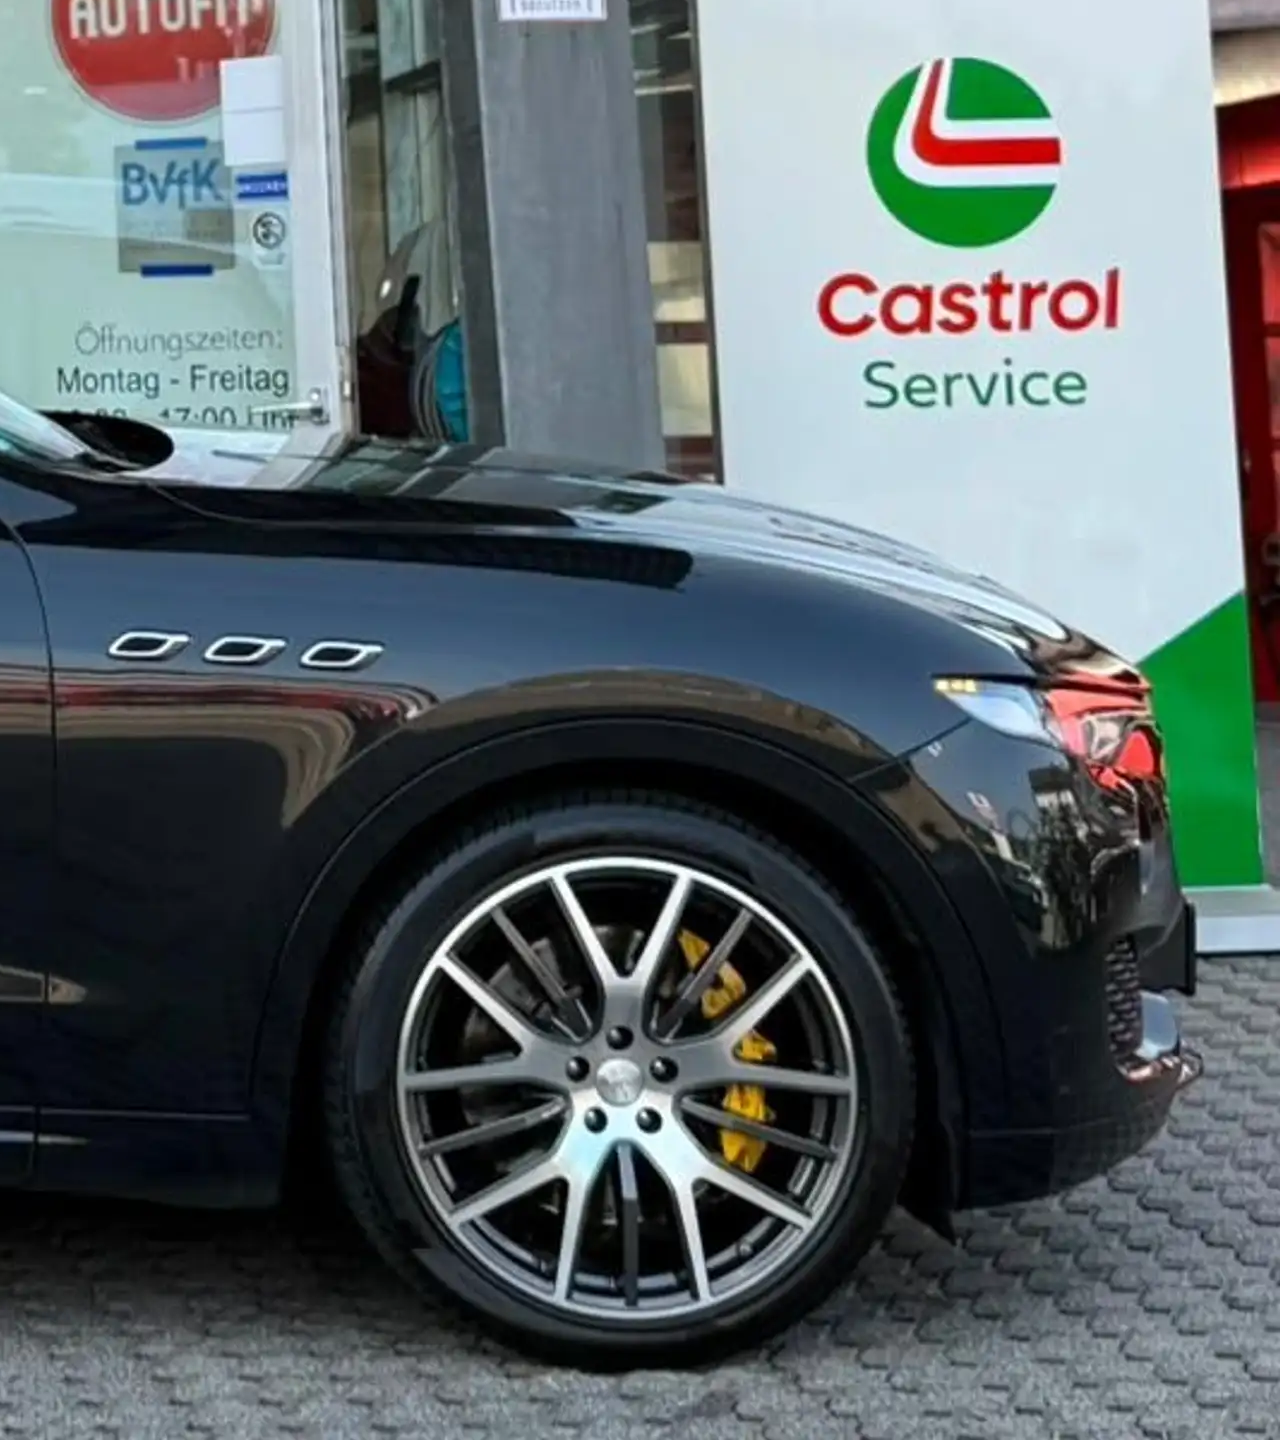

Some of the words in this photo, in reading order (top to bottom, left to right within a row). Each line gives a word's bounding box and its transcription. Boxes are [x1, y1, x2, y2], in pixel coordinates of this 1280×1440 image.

[818, 266, 1120, 337] Castrol
[75, 321, 283, 359] Öffnungszeiten:
[57, 366, 160, 399] Montag
[189, 364, 289, 397] Freitag
[863, 357, 1088, 409] Service
